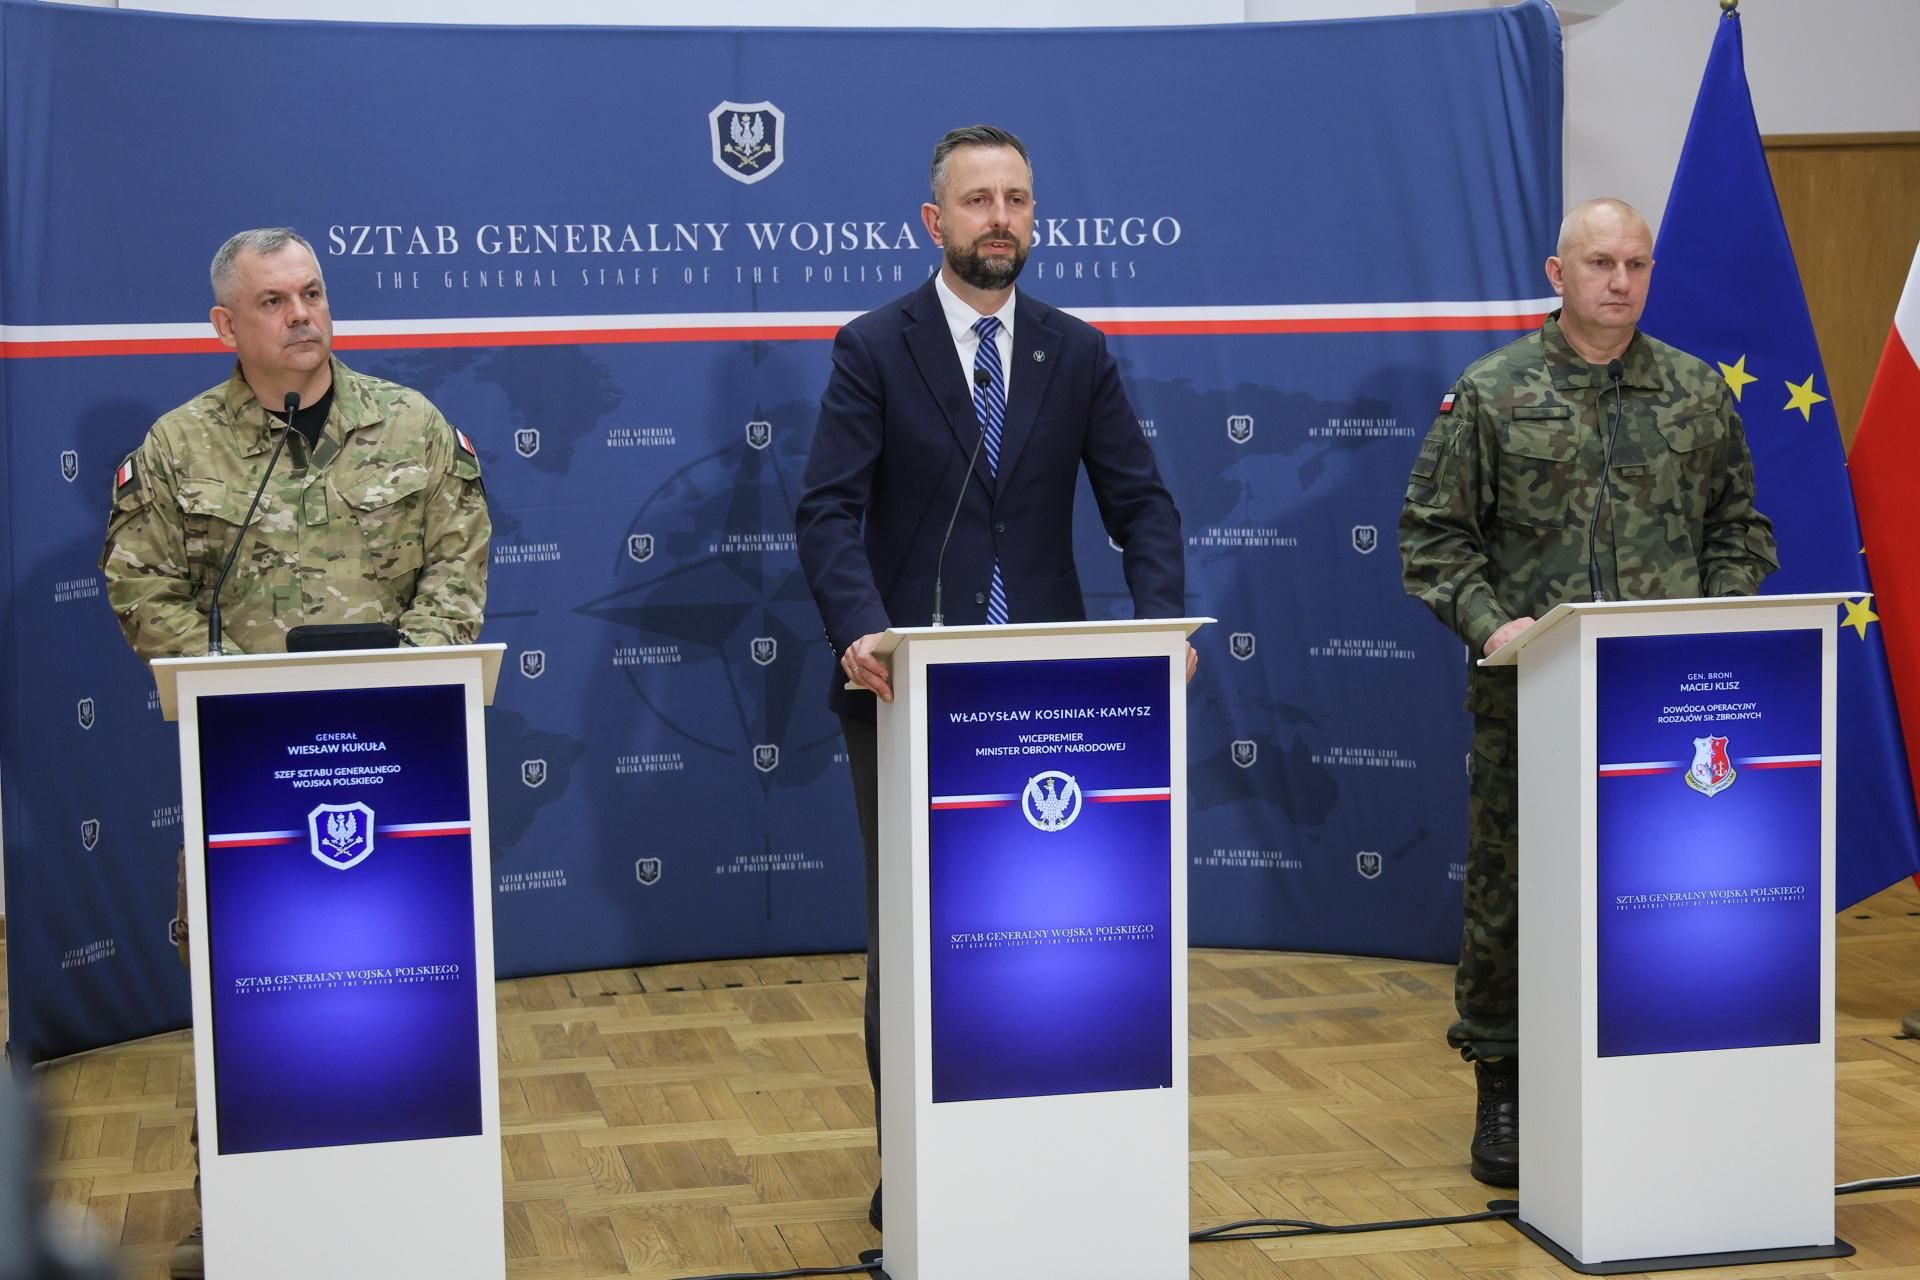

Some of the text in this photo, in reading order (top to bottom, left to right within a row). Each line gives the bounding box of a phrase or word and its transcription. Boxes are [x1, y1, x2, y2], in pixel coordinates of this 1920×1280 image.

[328, 217, 1182, 256] SZTAB GENERALNY WOJSKA SKIEGO
[376, 261, 1136, 289] THE GENERAL STAFF OF THE POLISH FORCES
[1687, 671, 1732, 681] GEN. BRONI
[1680, 681, 1740, 692] MACIEJ KLISZ
[949, 706, 1151, 723] WŁADYSŁAW KOSINIAK-KAMYSZ
[1663, 702, 1757, 714] DOWÓDCA OPERACYJNY
[1657, 711, 1762, 724] RODZAJÓW SIŁ ZBROJNYCH
[315, 732, 358, 742] GENERAŁ
[1018, 732, 1084, 744] WICEPREMIER
[287, 741, 387, 756] WIESŁAW KUKUŁA
[975, 742, 1126, 757] MINISTER OBRONY NARODOWEJ
[274, 764, 402, 779] SZEF SZTABU GENERALNEGO
[292, 775, 384, 789] WOJSKA POLSKIEGO
[1616, 885, 1805, 905] SZTAB GENERALNY WOJSKA POLSKIEGO
[950, 924, 1154, 943] SZTAB GENERALNY WOJSKA POLSKIEGO
[235, 964, 459, 988] SZTAB GENERALNY WOJSKA POLSKIEGO
